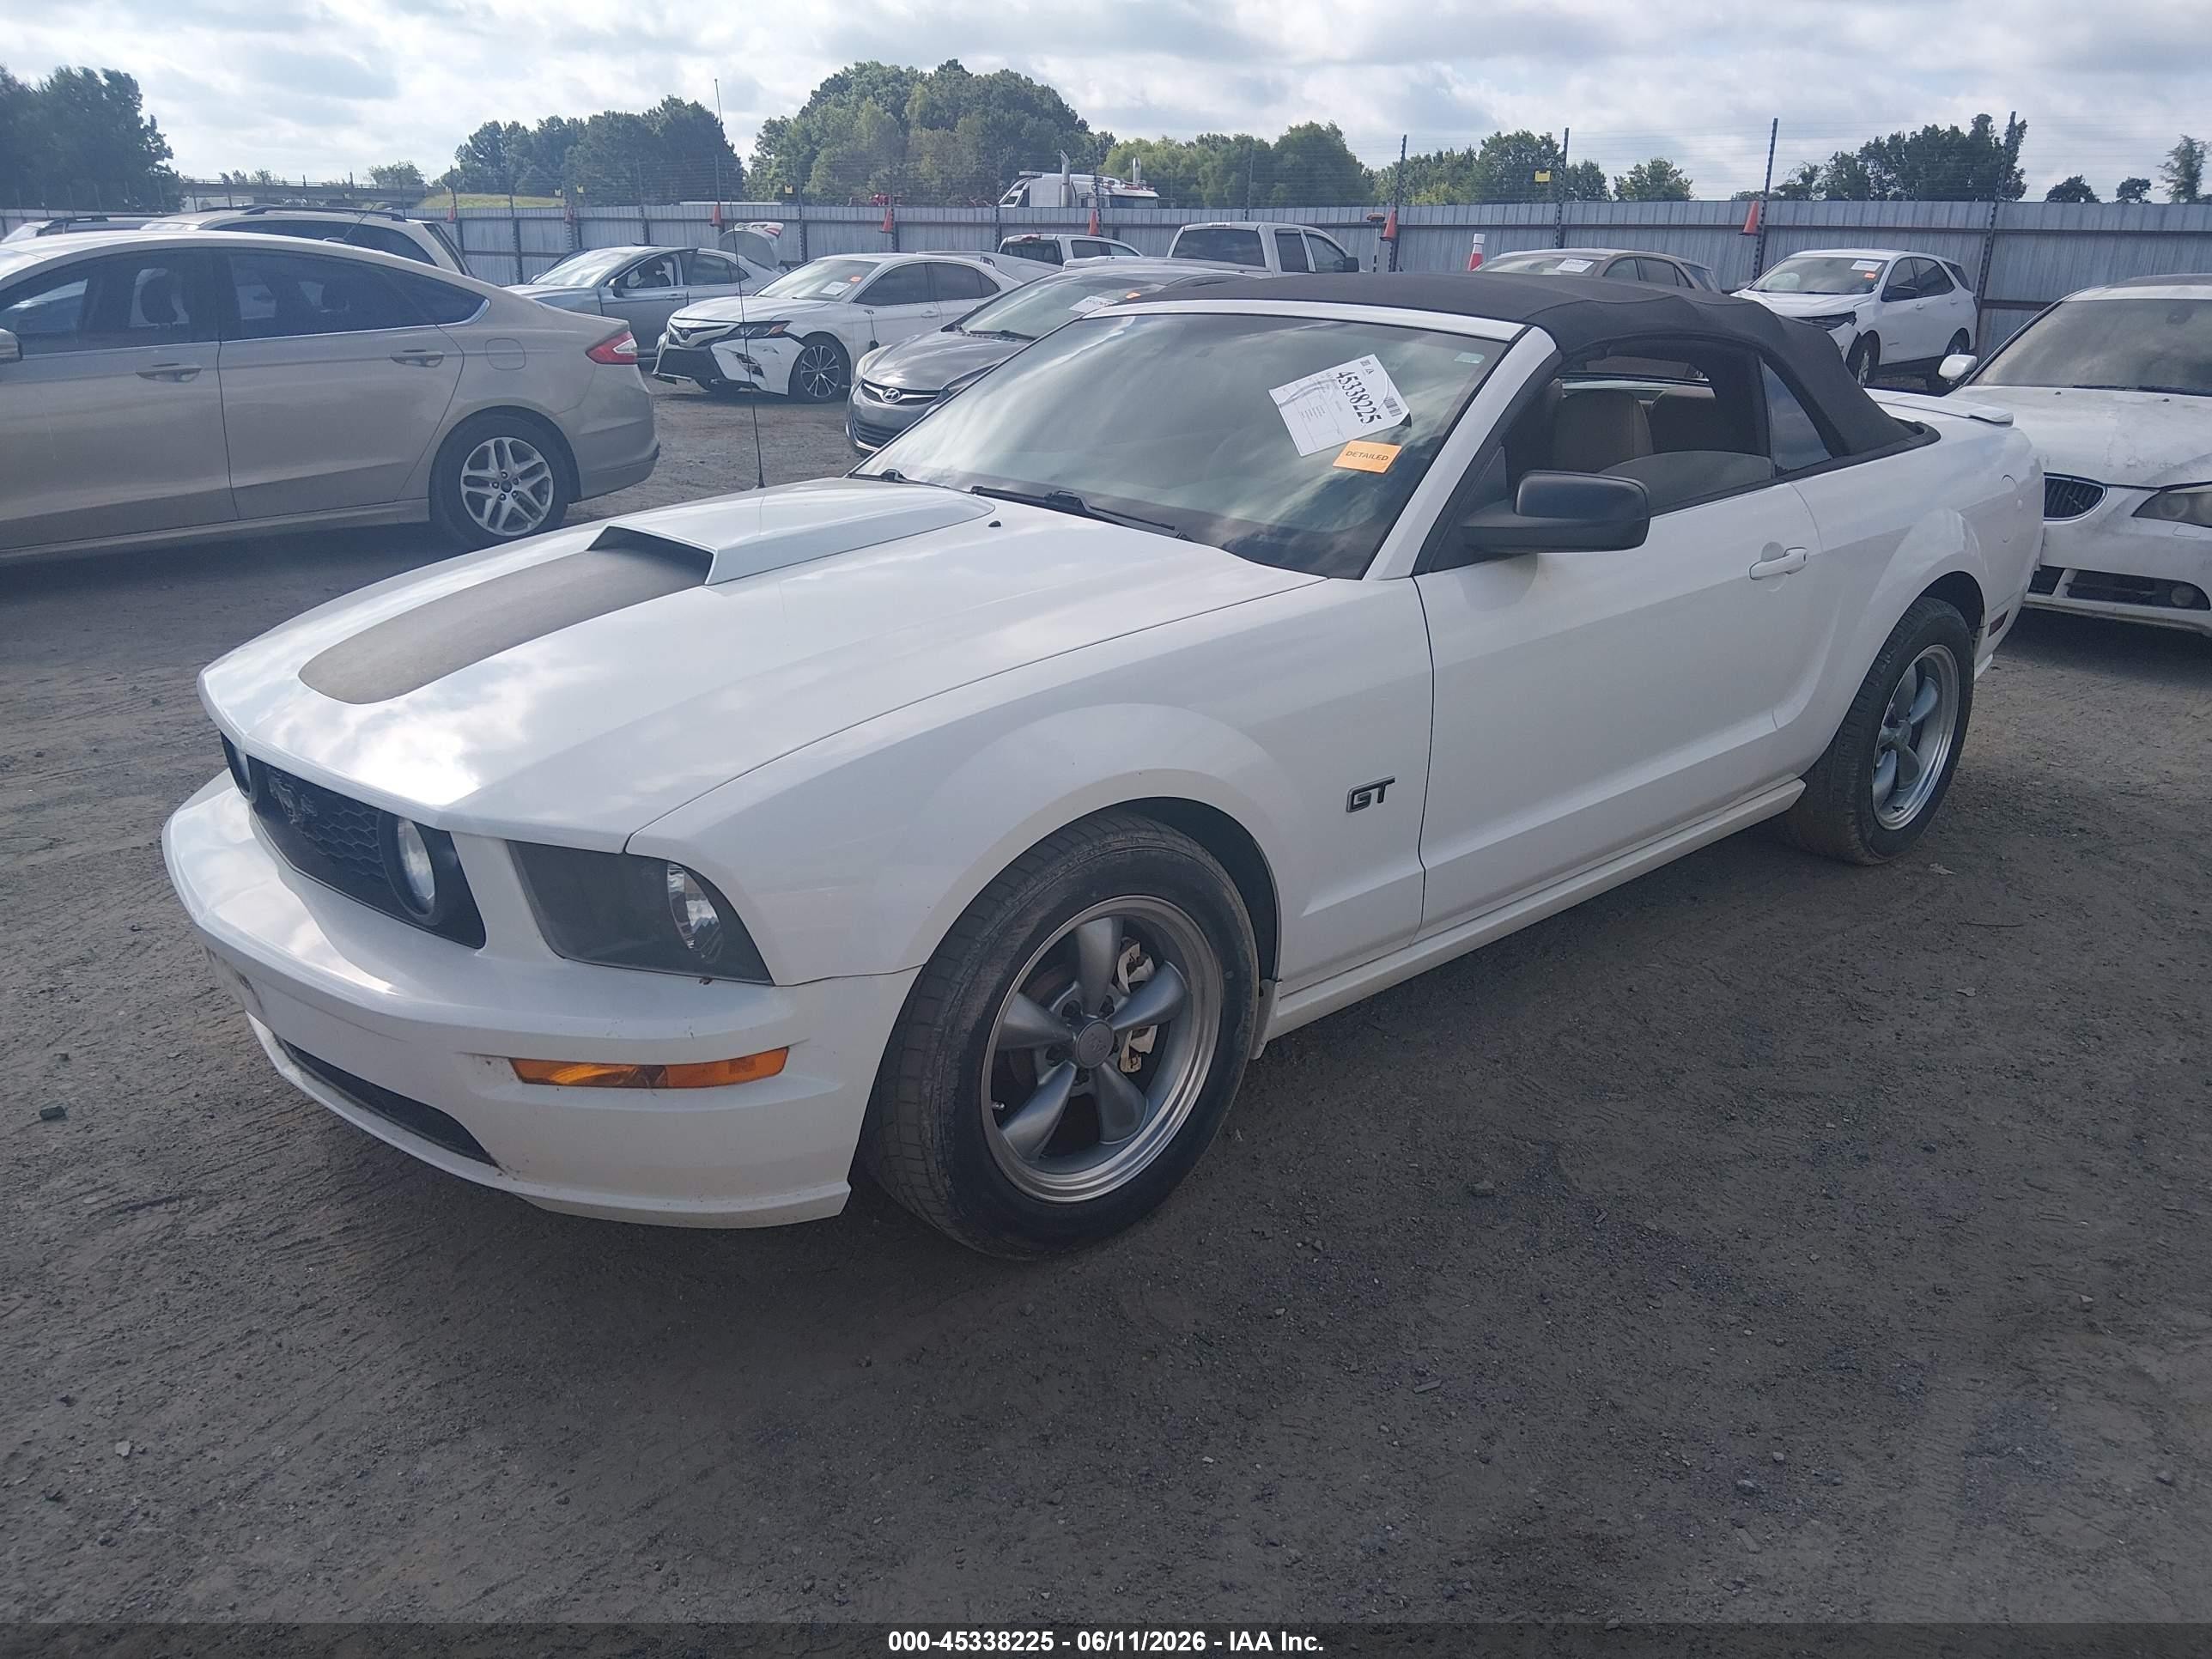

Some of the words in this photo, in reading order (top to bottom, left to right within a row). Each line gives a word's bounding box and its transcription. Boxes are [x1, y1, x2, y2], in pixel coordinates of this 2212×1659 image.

[1335, 371, 1382, 424] 45338225
[1346, 451, 1389, 461] DETAILED
[1346, 775, 1395, 813] GT
